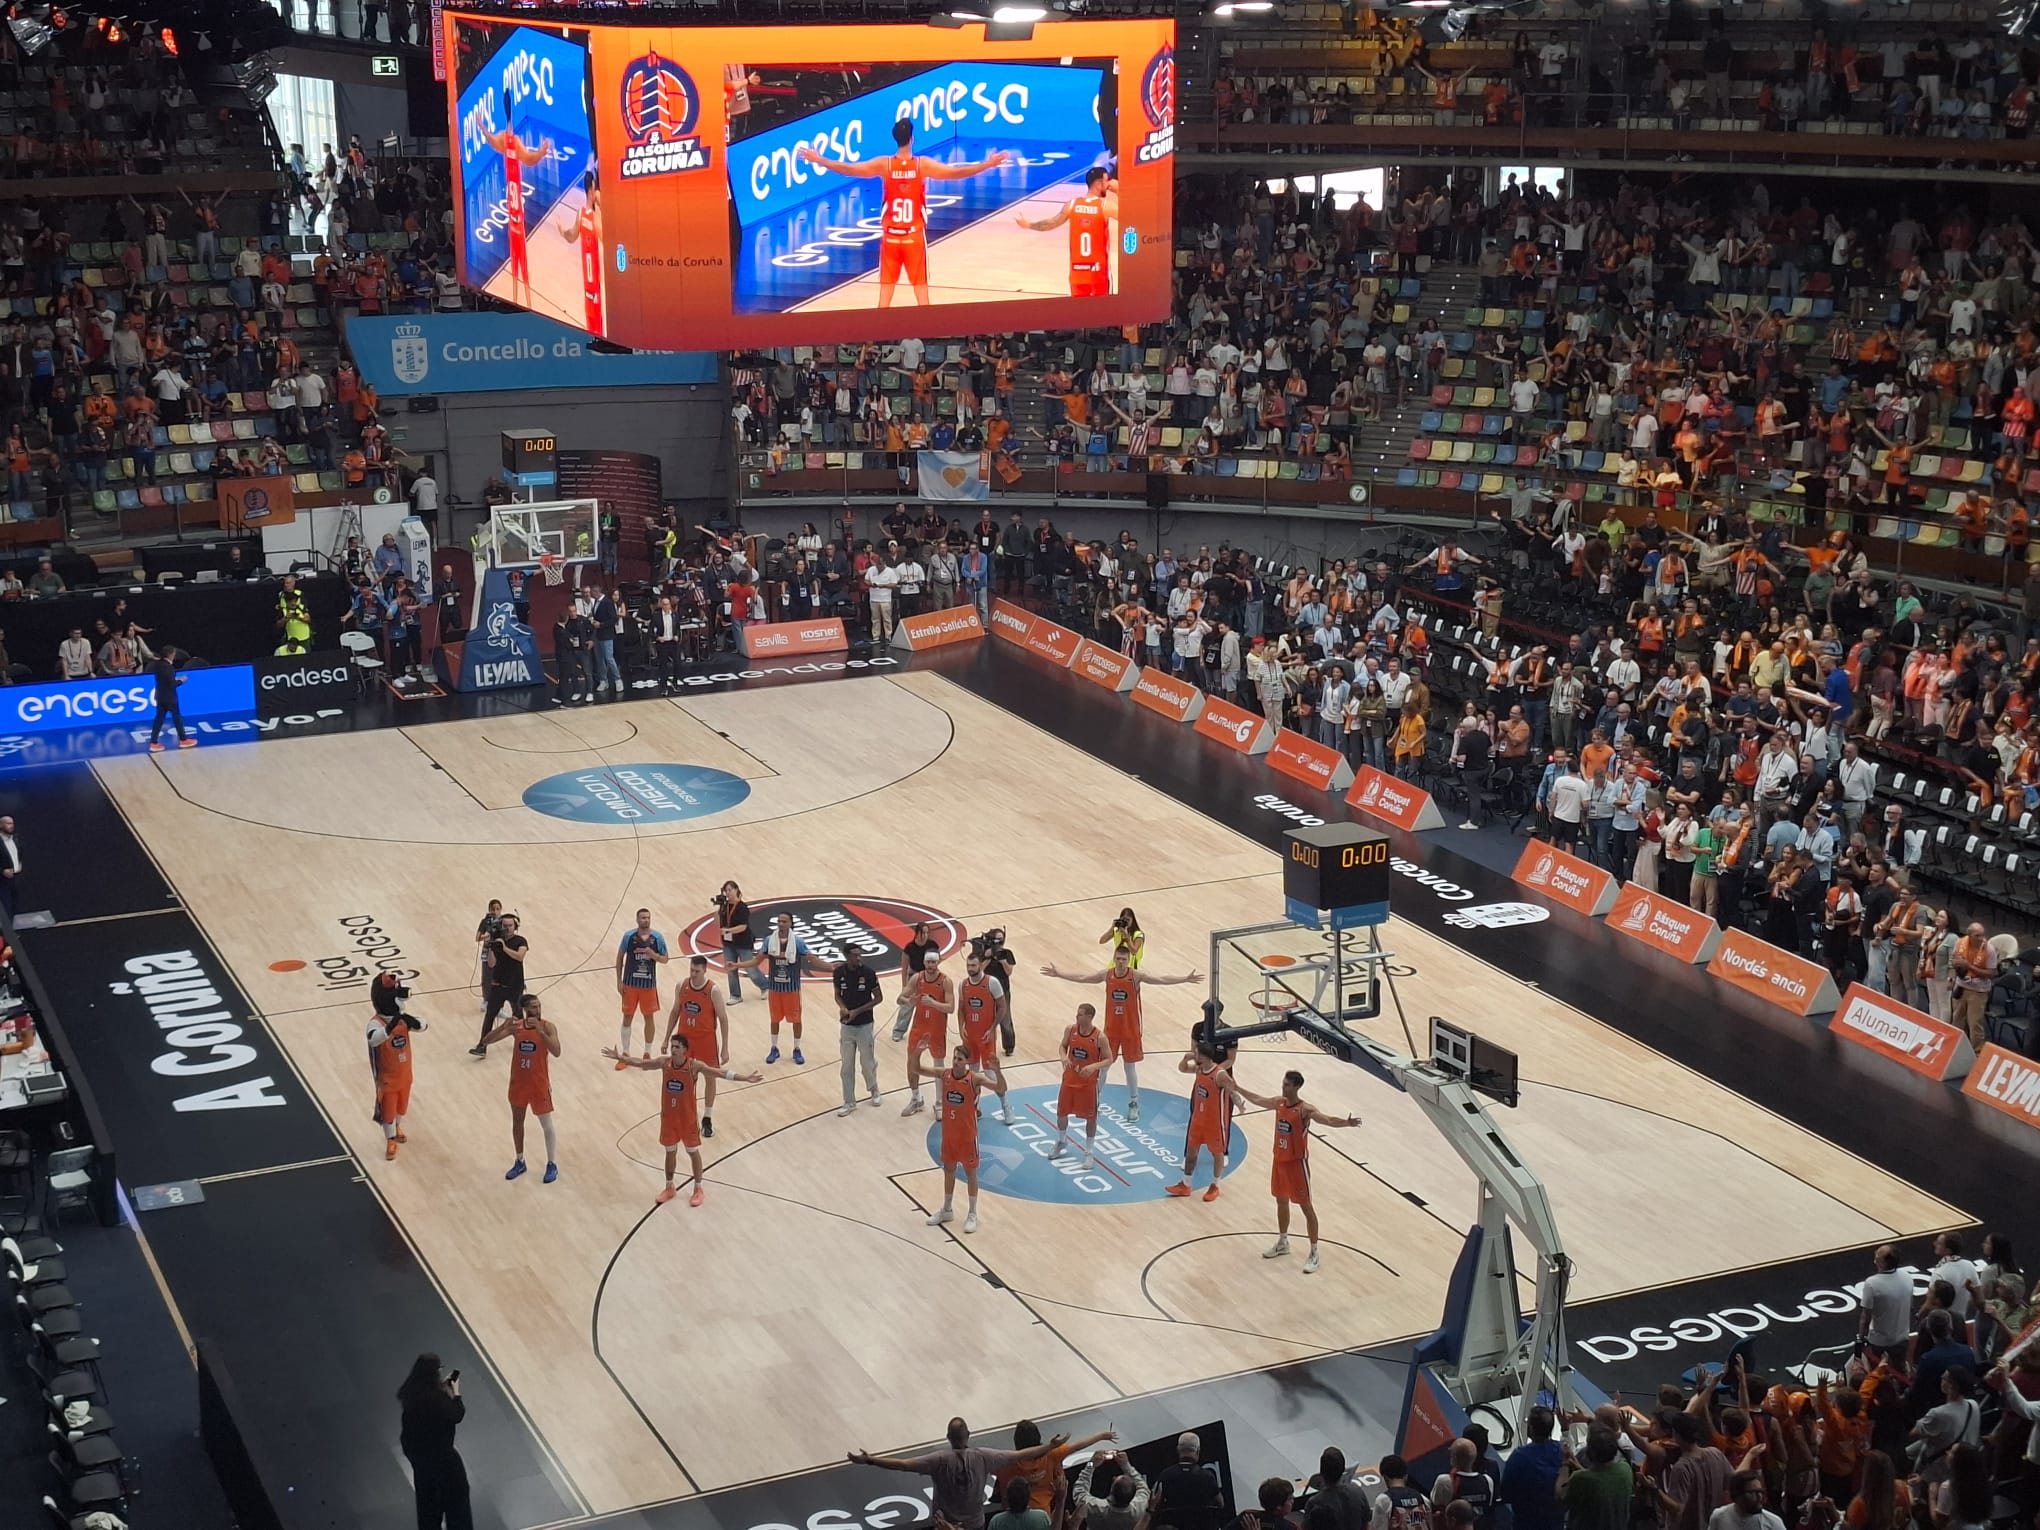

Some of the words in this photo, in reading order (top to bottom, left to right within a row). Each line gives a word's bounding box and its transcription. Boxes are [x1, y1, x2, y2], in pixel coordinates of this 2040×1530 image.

[892, 198, 913, 223] 50
[1081, 231, 1092, 257] 0
[442, 339, 546, 362] Concello
[552, 336, 582, 358] da
[379, 490, 387, 502] 6
[260, 666, 348, 690] endesa
[474, 659, 532, 688] LEYMA
[575, 774, 643, 819] OMODA
[1253, 793, 1326, 828] oruña
[1292, 842, 1320, 869] 0:00
[1342, 843, 1387, 868] 0:00
[1550, 877, 1581, 898] Coruña
[1555, 865, 1590, 887] Básquet
[1648, 922, 1682, 945] Coruña
[1654, 910, 1692, 934] Básquet
[313, 955, 371, 991] liga
[1721, 947, 1769, 979] Nordés
[1771, 973, 1807, 998] ancín
[108, 949, 258, 1077] Coruña
[1851, 1006, 1910, 1045] Aluman
[520, 1058, 531, 1070] 24
[172, 1075, 287, 1113] A
[1976, 1054, 2040, 1117] LEYM
[1098, 1102, 1184, 1168] resnovamoto
